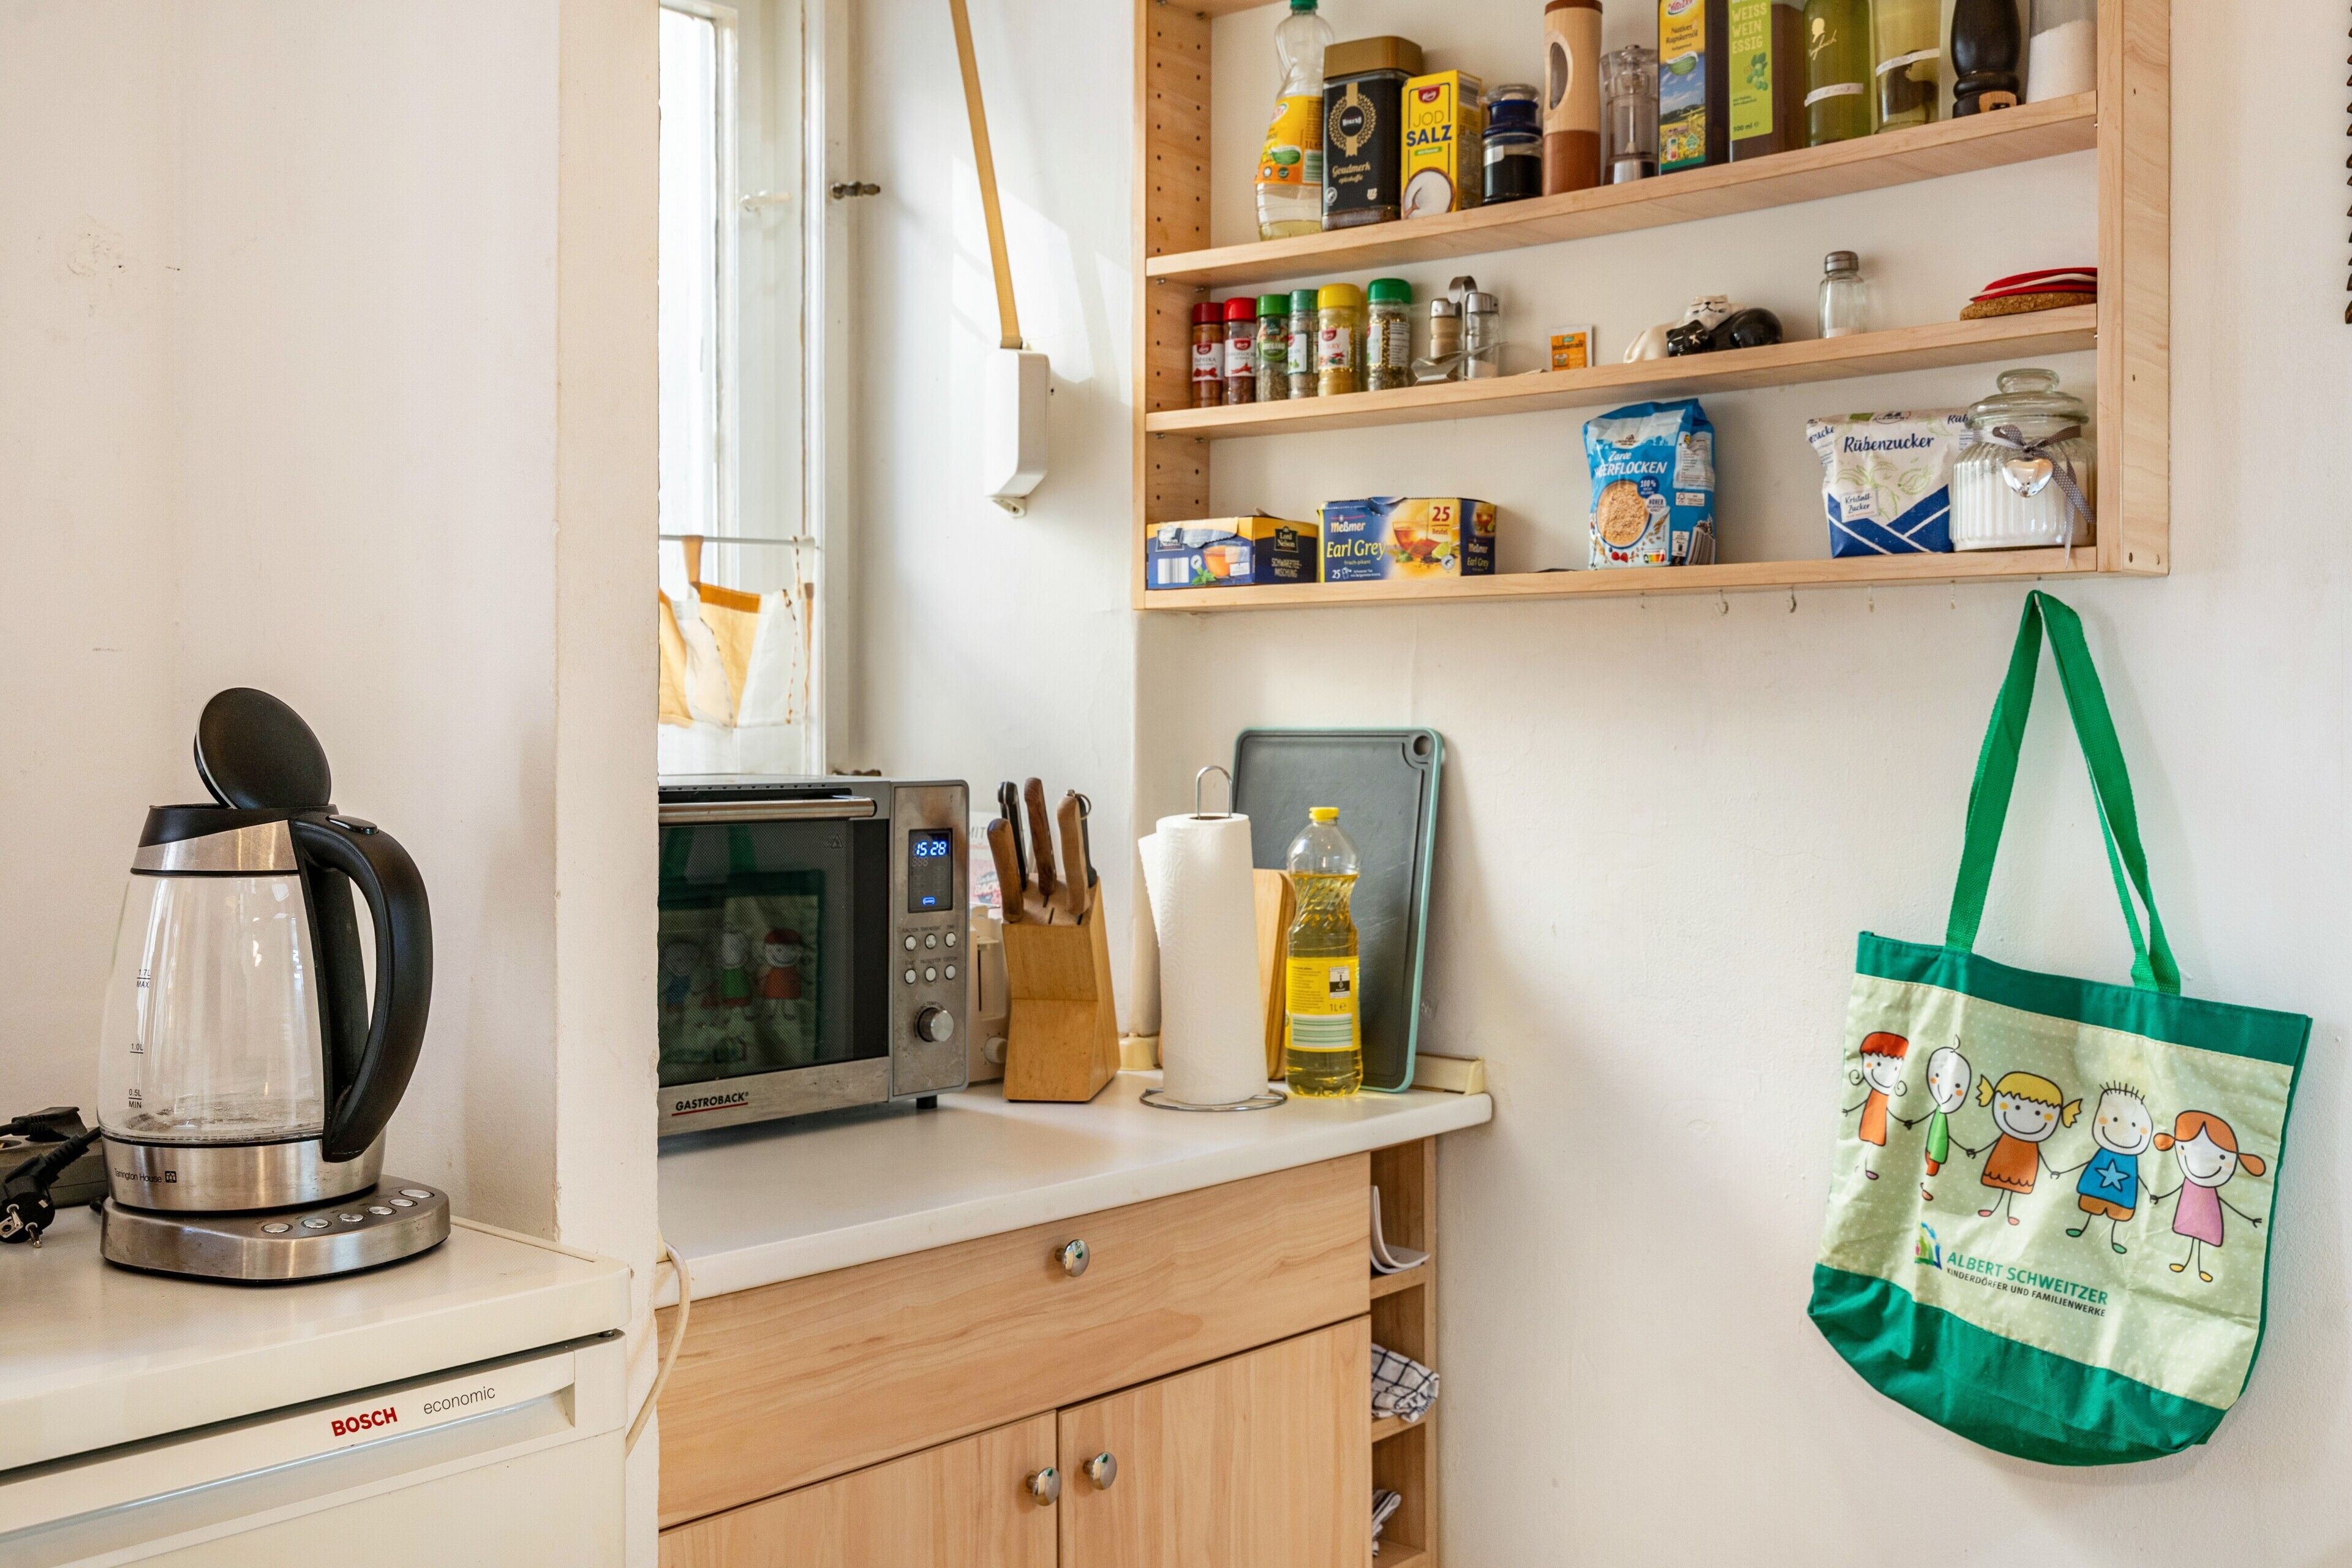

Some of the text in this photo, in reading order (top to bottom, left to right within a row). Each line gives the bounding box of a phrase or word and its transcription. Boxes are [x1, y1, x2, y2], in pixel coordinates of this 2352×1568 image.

[1732, 4, 1767, 21] WEISS
[1732, 20, 1762, 37] WEIN
[1732, 37, 1763, 53] ESSIG
[1413, 110, 1444, 127] JOD
[1406, 124, 1452, 147] SALZ
[1844, 433, 1934, 453] Rübenzucker
[1432, 506, 1450, 522] 25
[1330, 521, 1366, 533] Meßmer
[1327, 538, 1384, 561] Earl Grey
[1332, 569, 1341, 579] 25
[140, 1173, 162, 1183] House
[1947, 1252, 2108, 1305] ALBERT SCHWEITZER
[1947, 1267, 2106, 1316] KINDERDÖRFER UND FAMILIENWERKE
[331, 1386, 496, 1436] BOSCH economic
